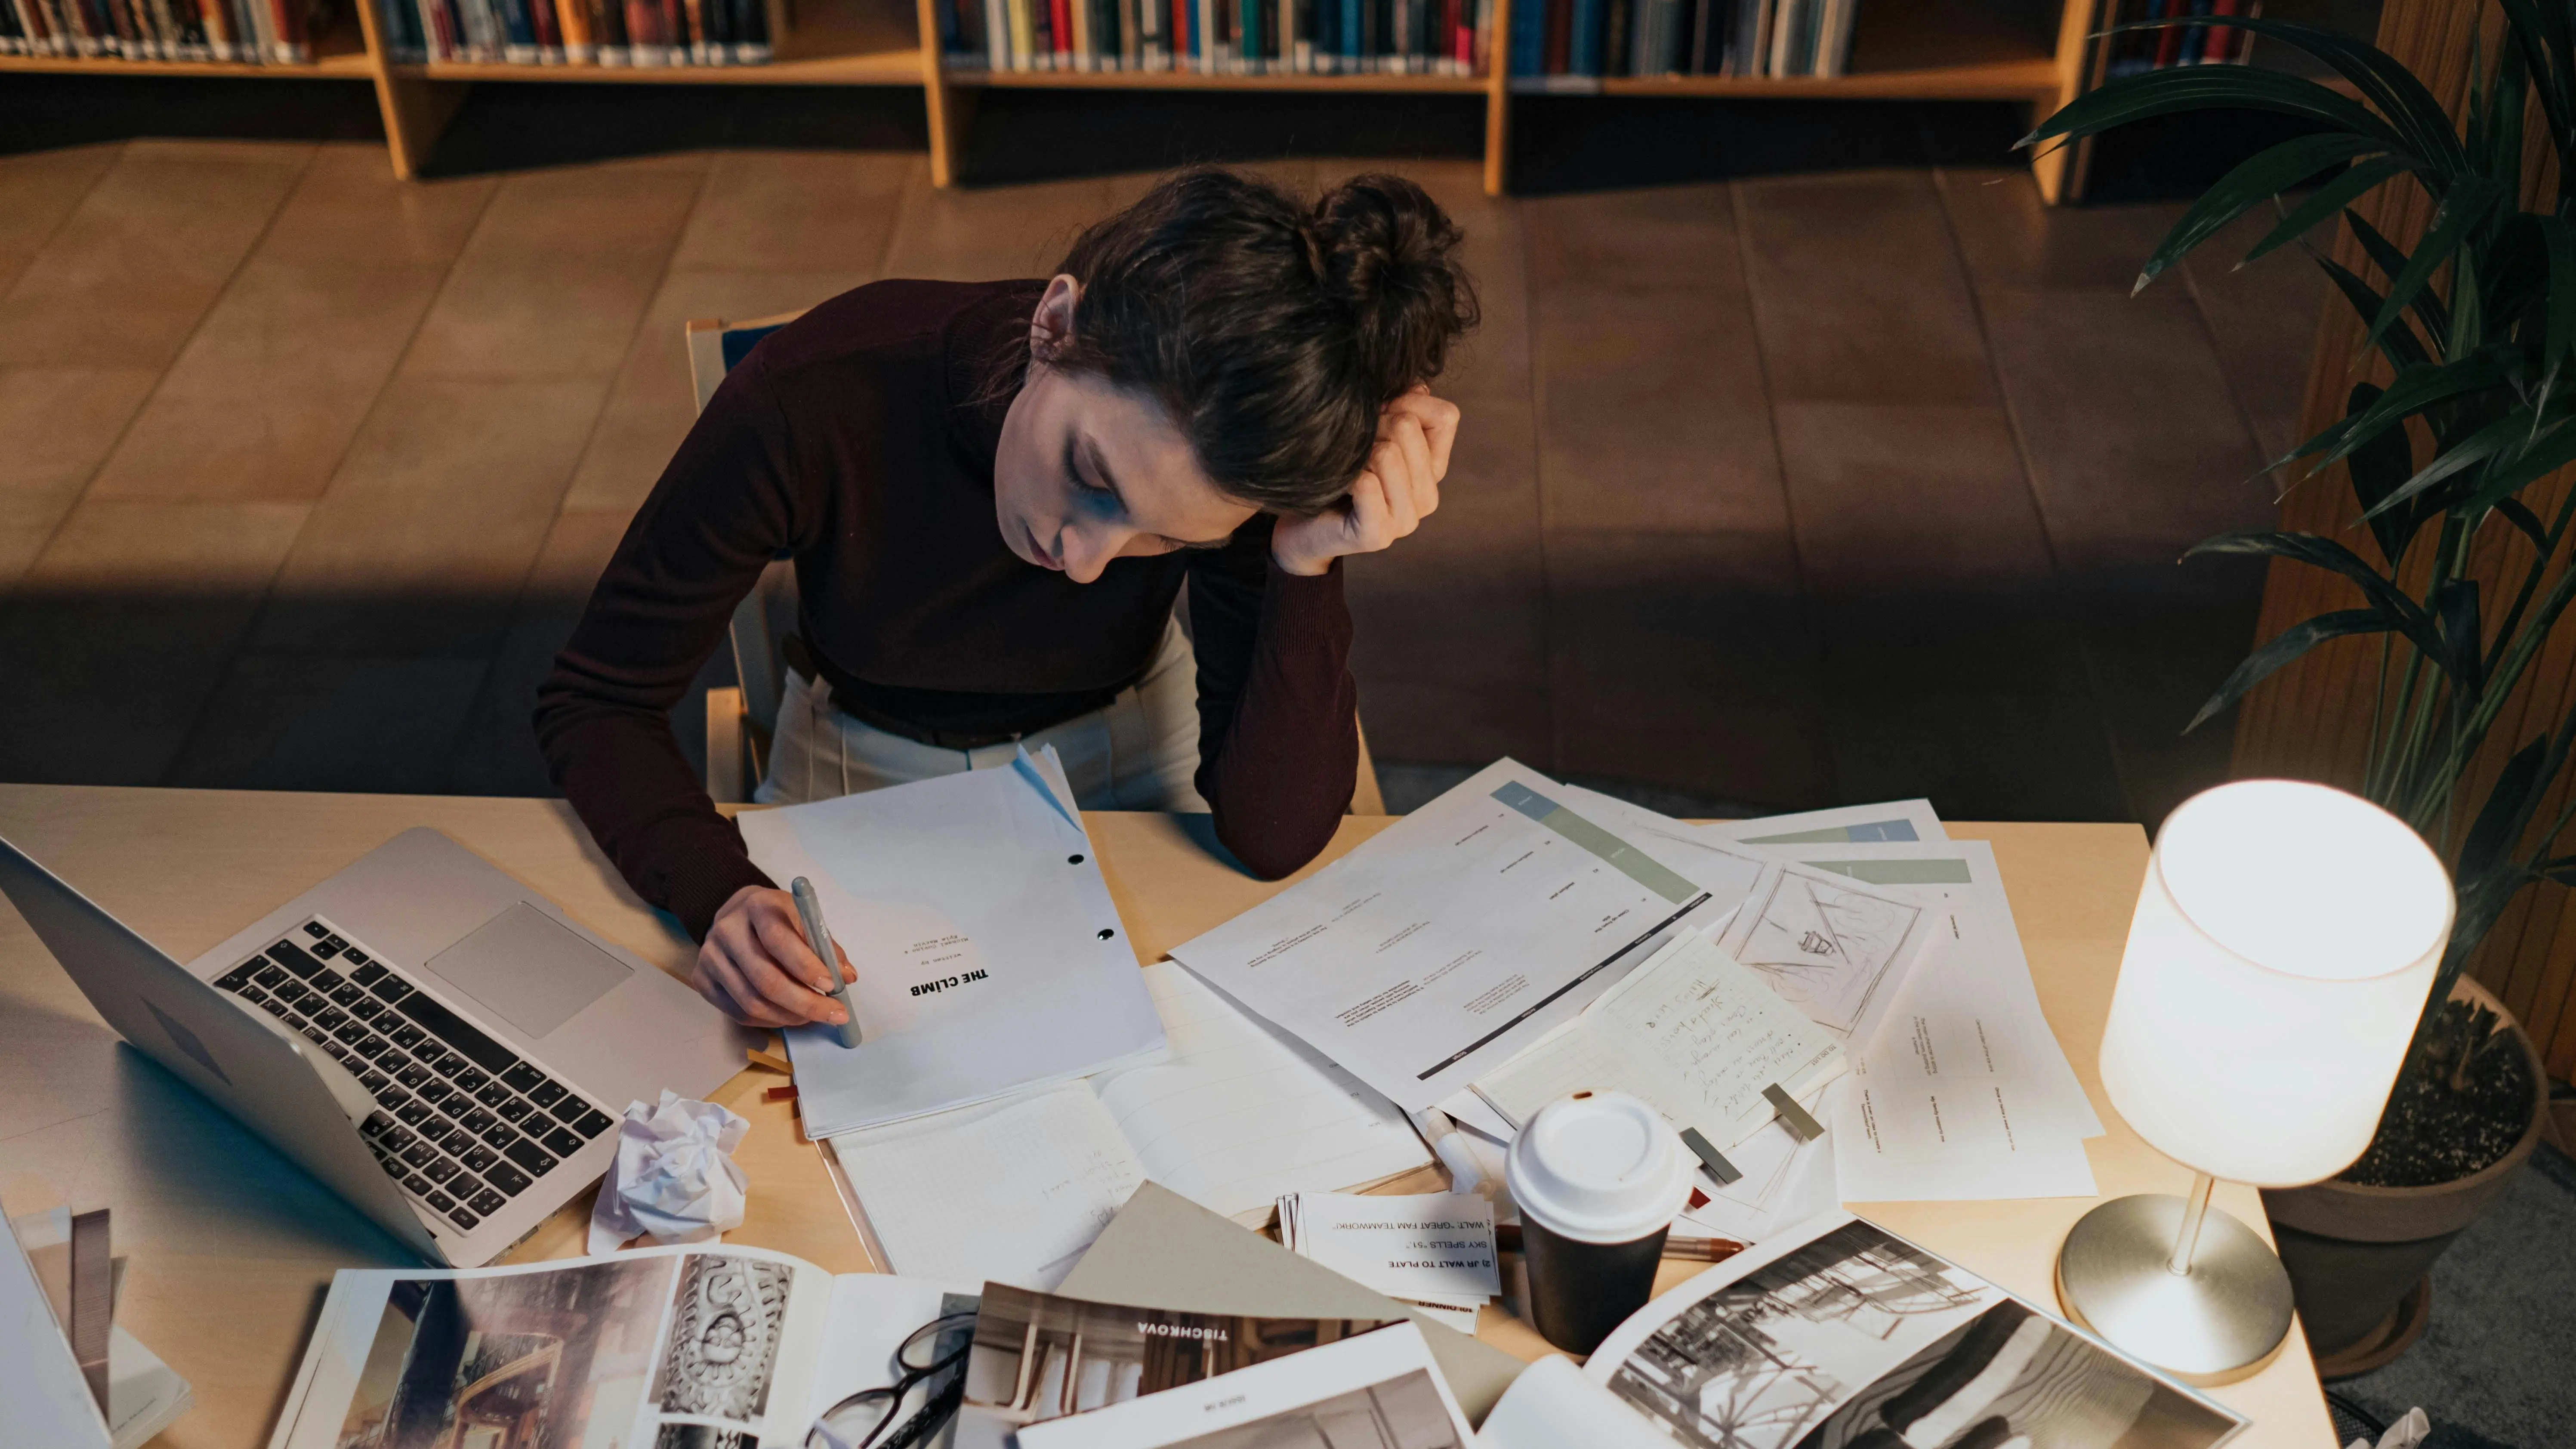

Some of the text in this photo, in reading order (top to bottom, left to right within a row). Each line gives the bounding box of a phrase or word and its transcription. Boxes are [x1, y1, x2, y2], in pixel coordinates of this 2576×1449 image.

[1689, 896, 1707, 908] Location
[1634, 933, 1651, 944] Camera
[932, 953, 962, 962] written
[961, 969, 989, 983] THE
[1579, 965, 1603, 980] Storyboard
[1521, 1007, 1536, 1017] Action
[1452, 1051, 1467, 1060] Script
[1811, 1056, 1821, 1066] LIST
[1138, 1322, 1228, 1341] TISCHKOVA
